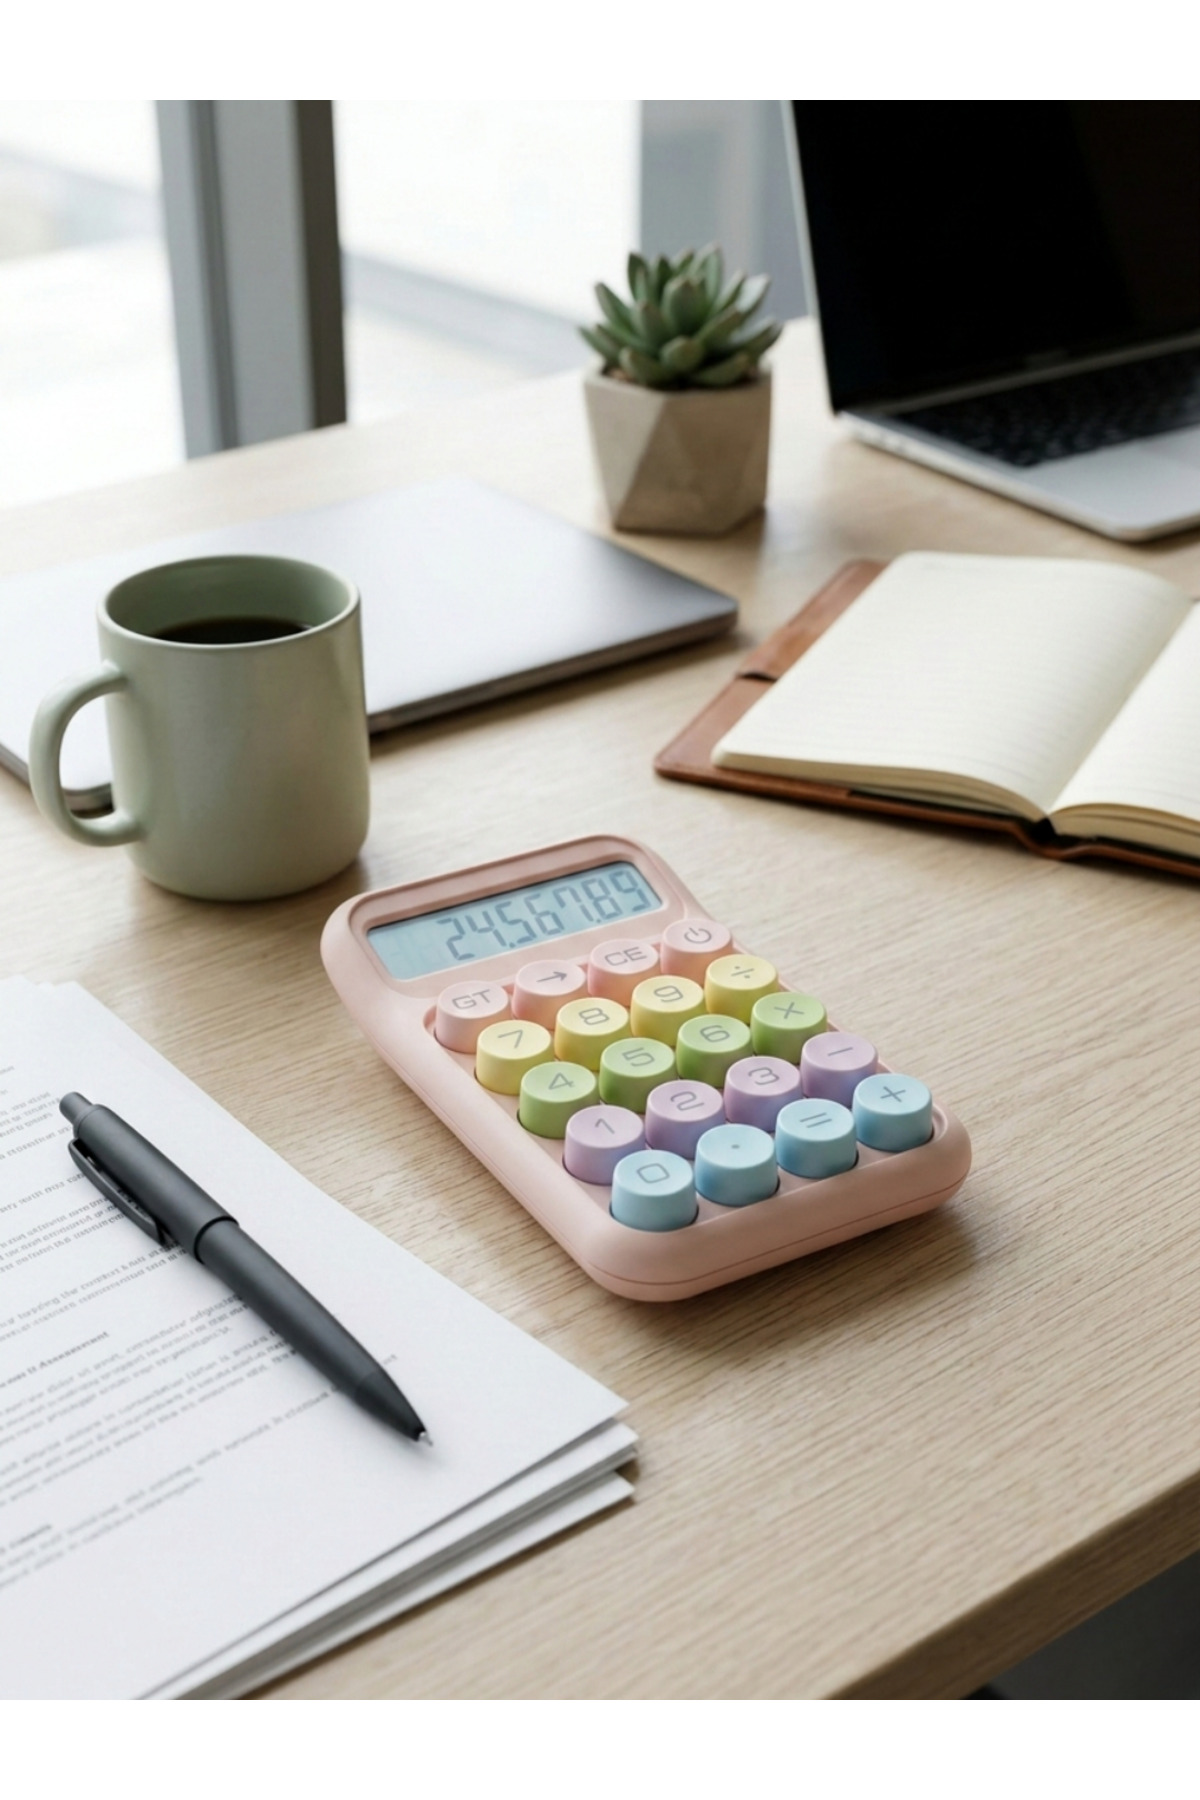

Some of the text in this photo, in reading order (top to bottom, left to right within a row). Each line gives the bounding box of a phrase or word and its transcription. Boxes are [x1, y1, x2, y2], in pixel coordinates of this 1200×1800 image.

[604, 947, 648, 967] CE
[452, 989, 491, 1010] GT
[653, 985, 684, 1003] 9
[578, 1007, 610, 1026] 8
[497, 1029, 524, 1049] 7
[700, 1025, 731, 1043] 6
[622, 1047, 655, 1067] 5
[547, 1072, 575, 1091] 4
[748, 1066, 781, 1086] 3
[670, 1091, 706, 1112] 2
[594, 1117, 616, 1135] 1
[636, 1163, 670, 1184] 0
